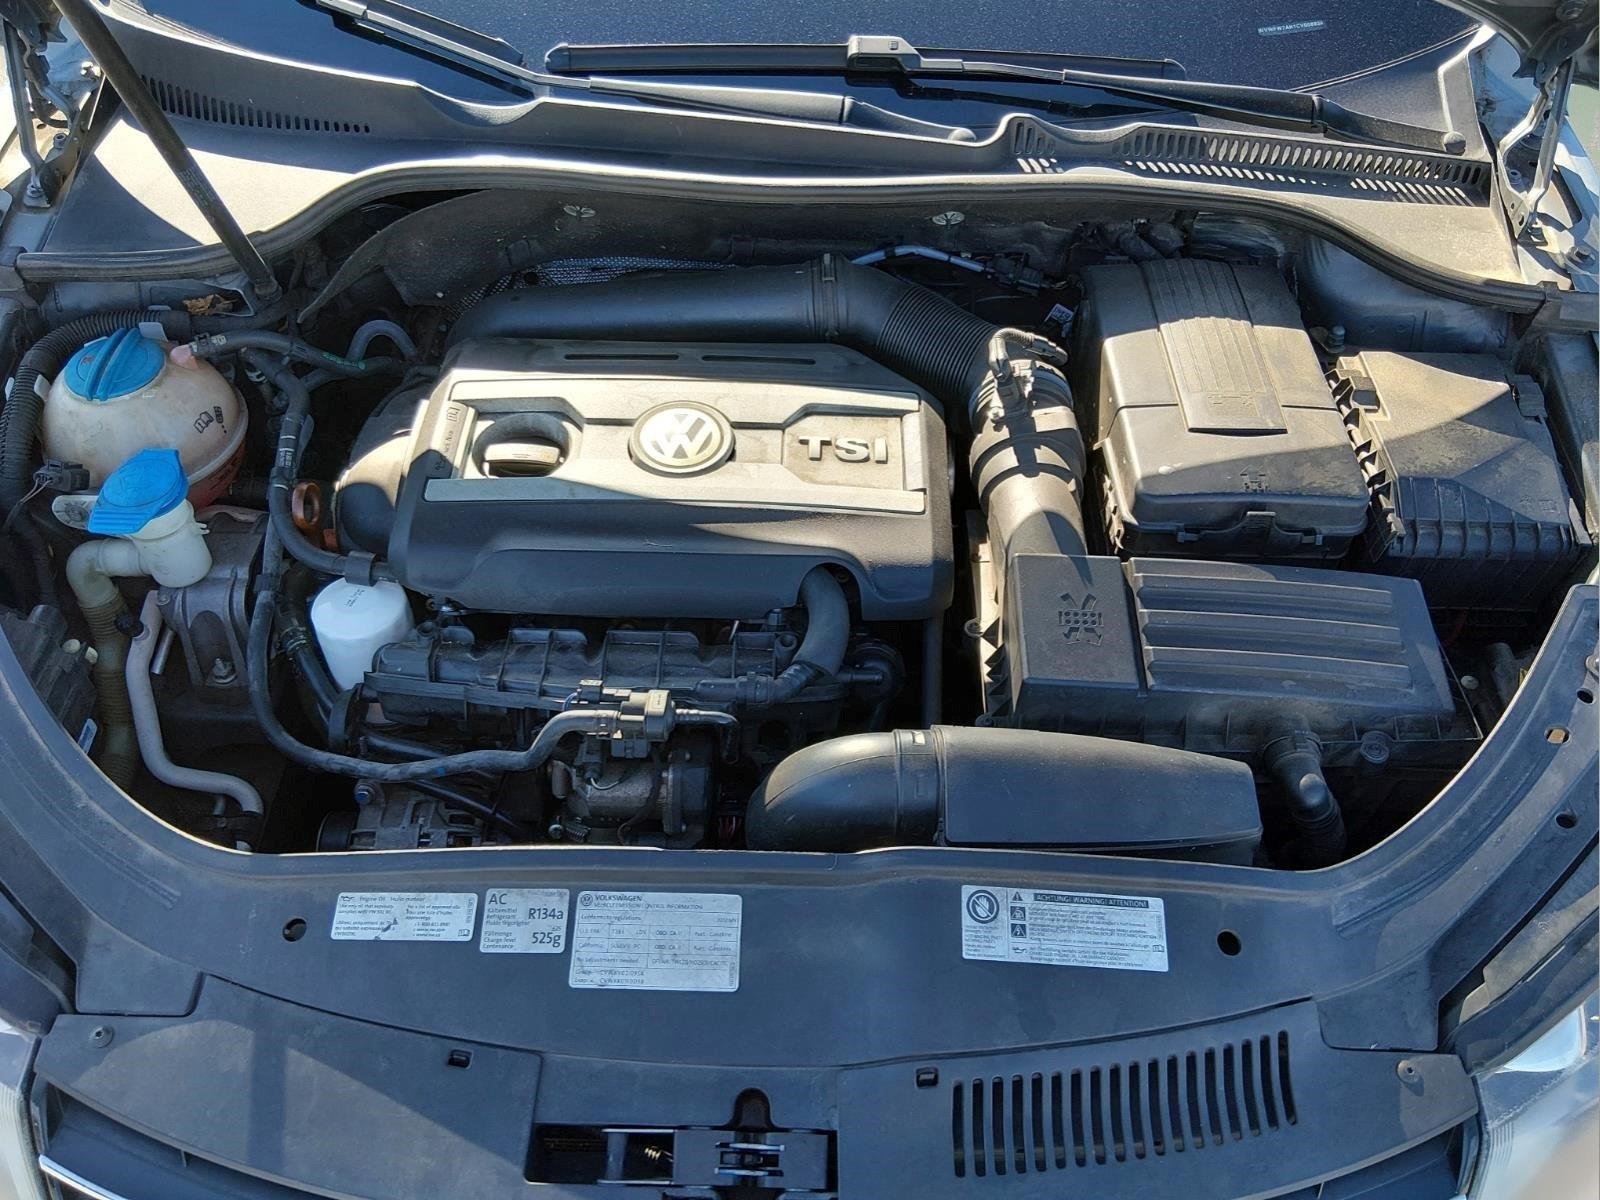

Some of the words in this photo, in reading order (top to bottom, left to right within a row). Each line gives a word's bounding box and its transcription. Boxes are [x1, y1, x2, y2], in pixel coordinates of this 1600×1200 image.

[799, 434, 889, 465] TSI
[489, 893, 508, 905] AC
[594, 894, 643, 902] VOLKSWAGEN
[1072, 896, 1108, 906] WARNING!
[528, 907, 564, 920] R134a
[532, 932, 562, 948] 525g
